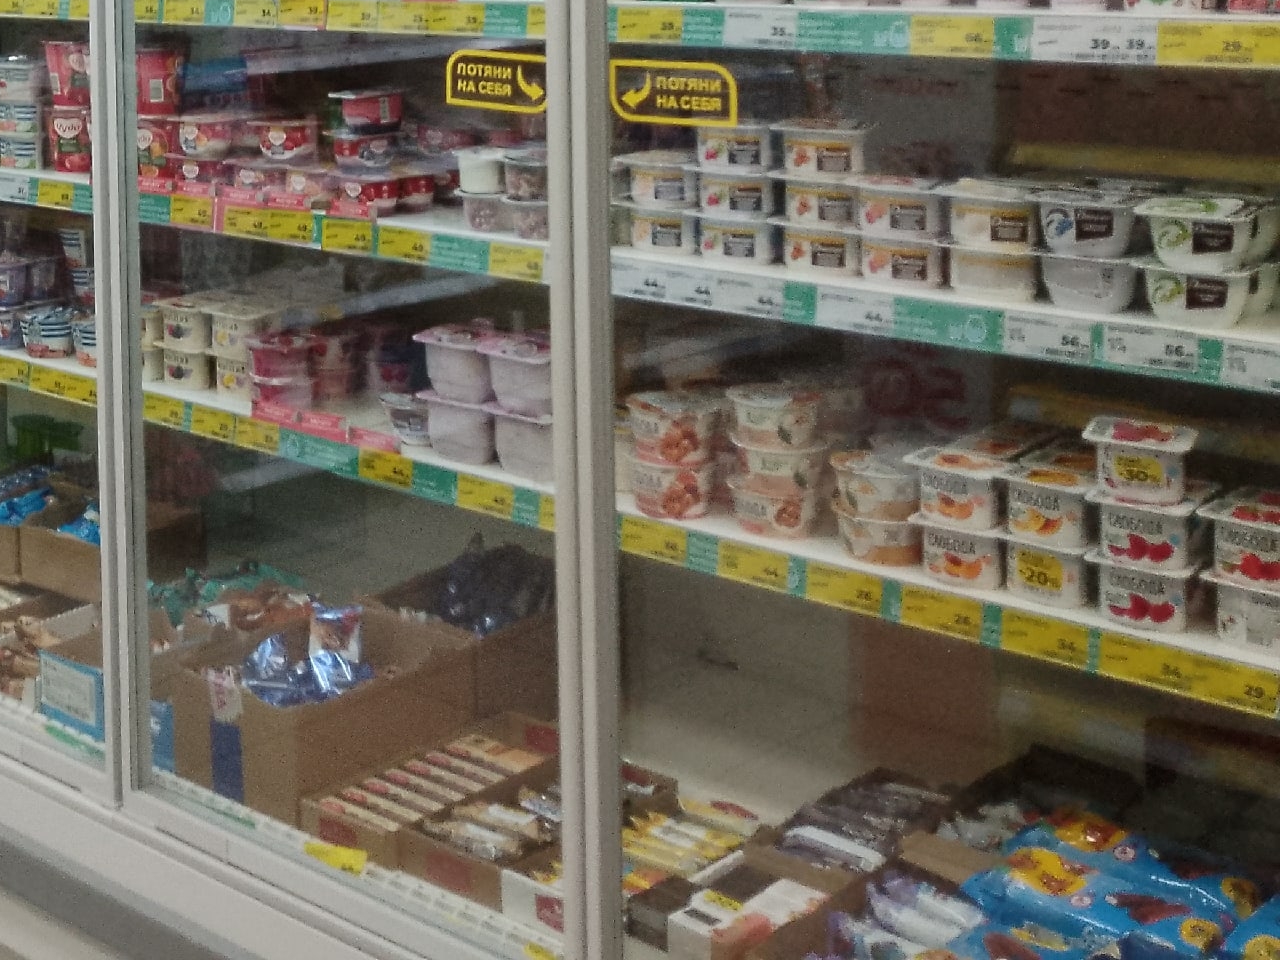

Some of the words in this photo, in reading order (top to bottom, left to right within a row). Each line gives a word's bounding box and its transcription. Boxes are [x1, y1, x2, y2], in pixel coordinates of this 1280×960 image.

[457, 63, 512, 79] ПОТЯНИ
[457, 80, 477, 93] НА
[479, 81, 512, 96] СЕБЯ
[656, 76, 722, 93] ПОТЯНИ
[656, 96, 678, 110] НА
[681, 96, 722, 111] СЕБЯ
